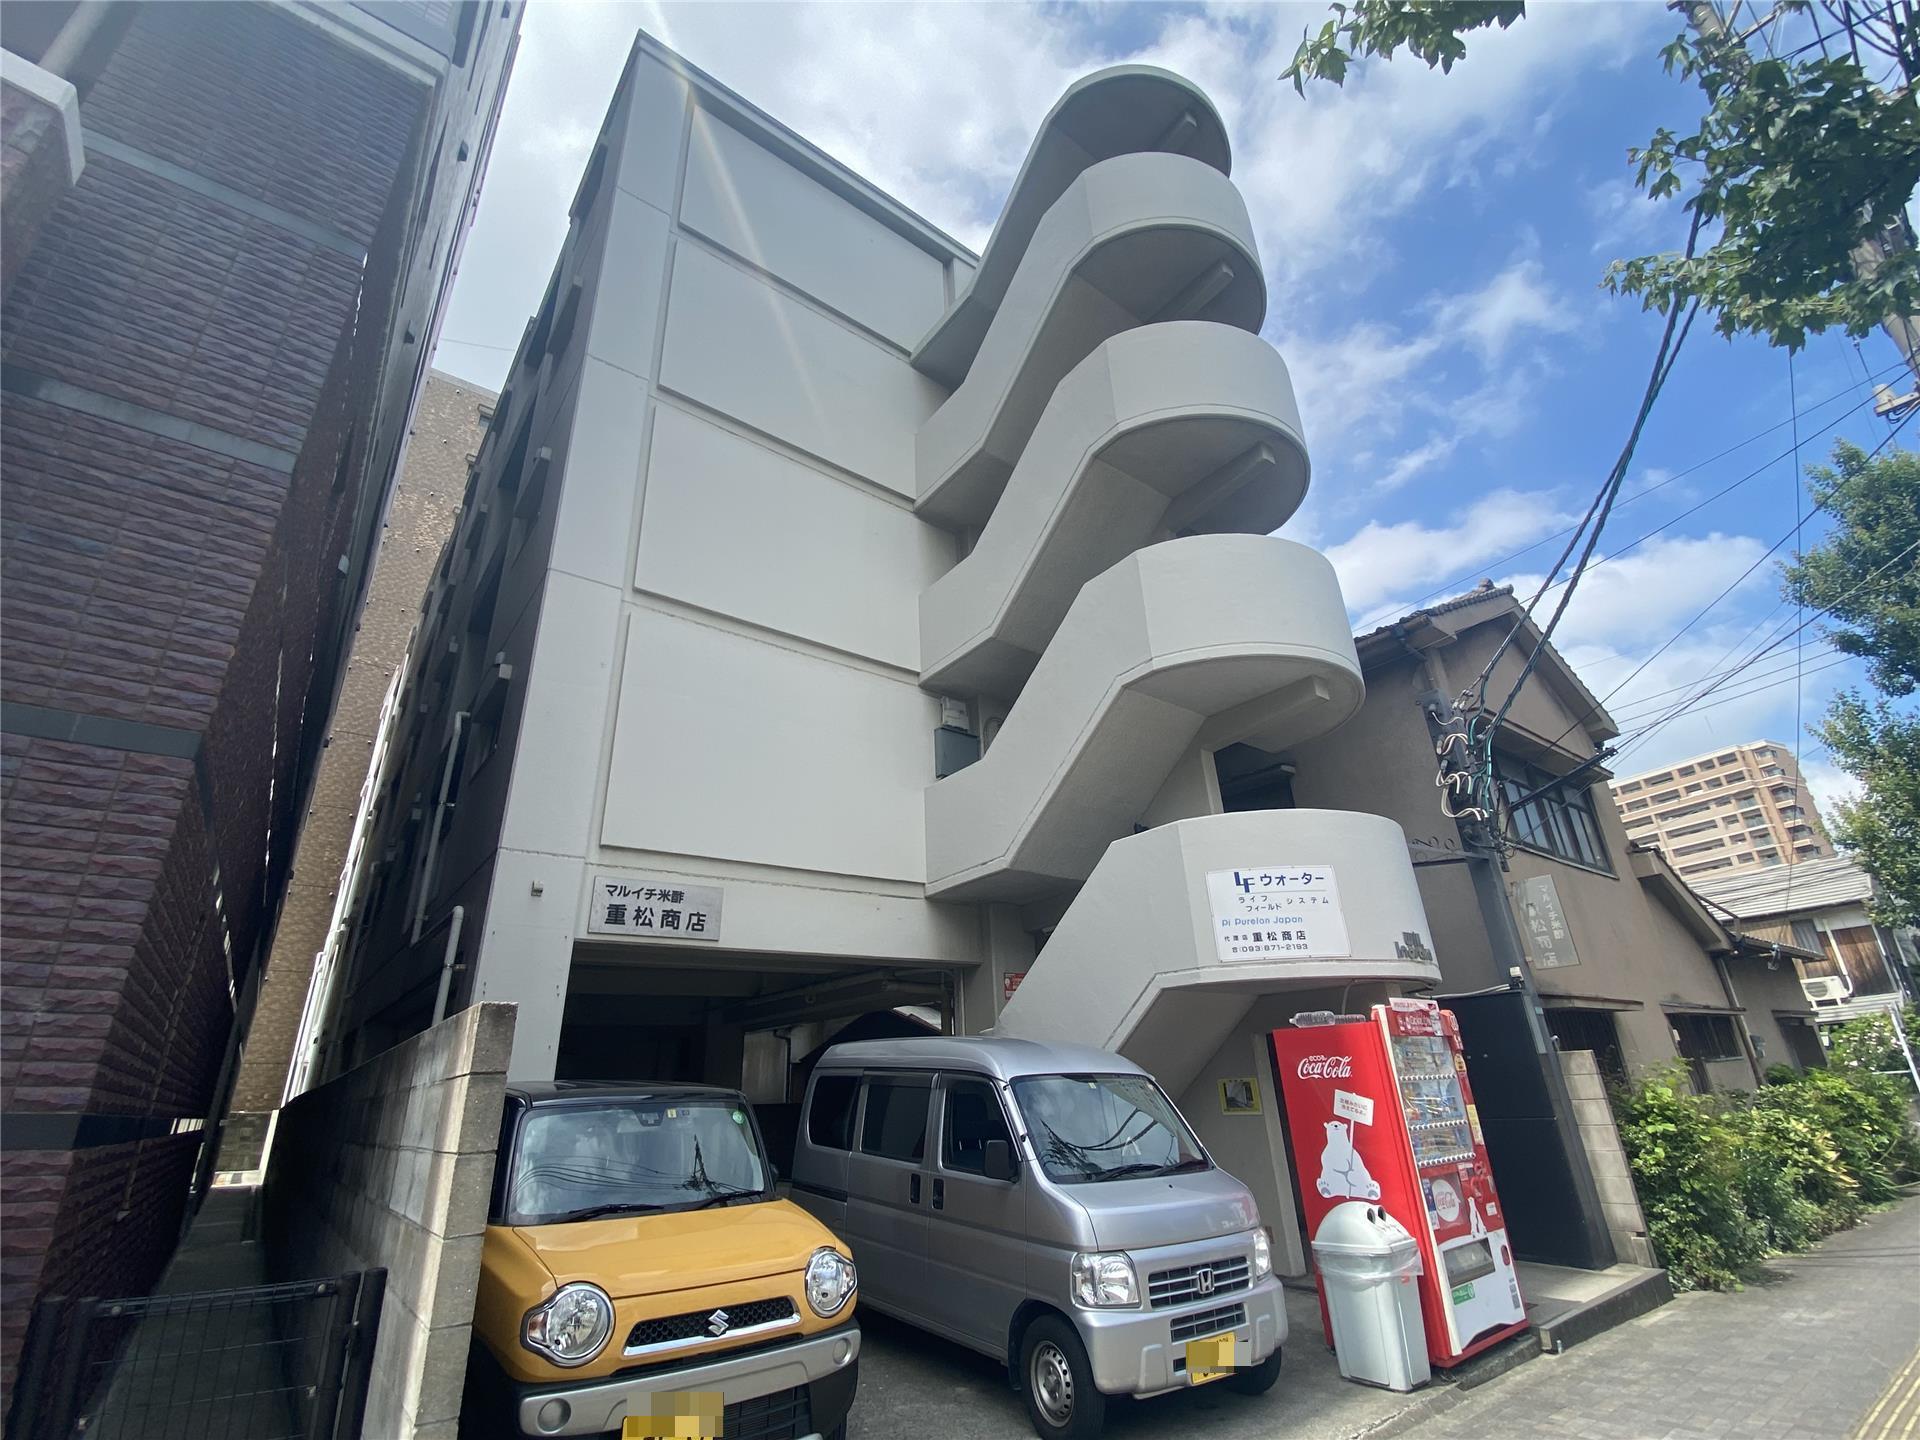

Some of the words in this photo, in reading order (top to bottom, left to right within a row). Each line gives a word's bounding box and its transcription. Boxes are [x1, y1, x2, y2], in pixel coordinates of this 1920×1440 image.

[605, 884, 685, 904] マルイチ米酢
[1238, 895, 1268, 904] ライフ
[1286, 897, 1329, 905] システム
[1245, 903, 1282, 912] フィールド
[604, 903, 707, 932] 重松商店
[1273, 915, 1303, 924] Japan
[1252, 930, 1306, 943] 重松商店
